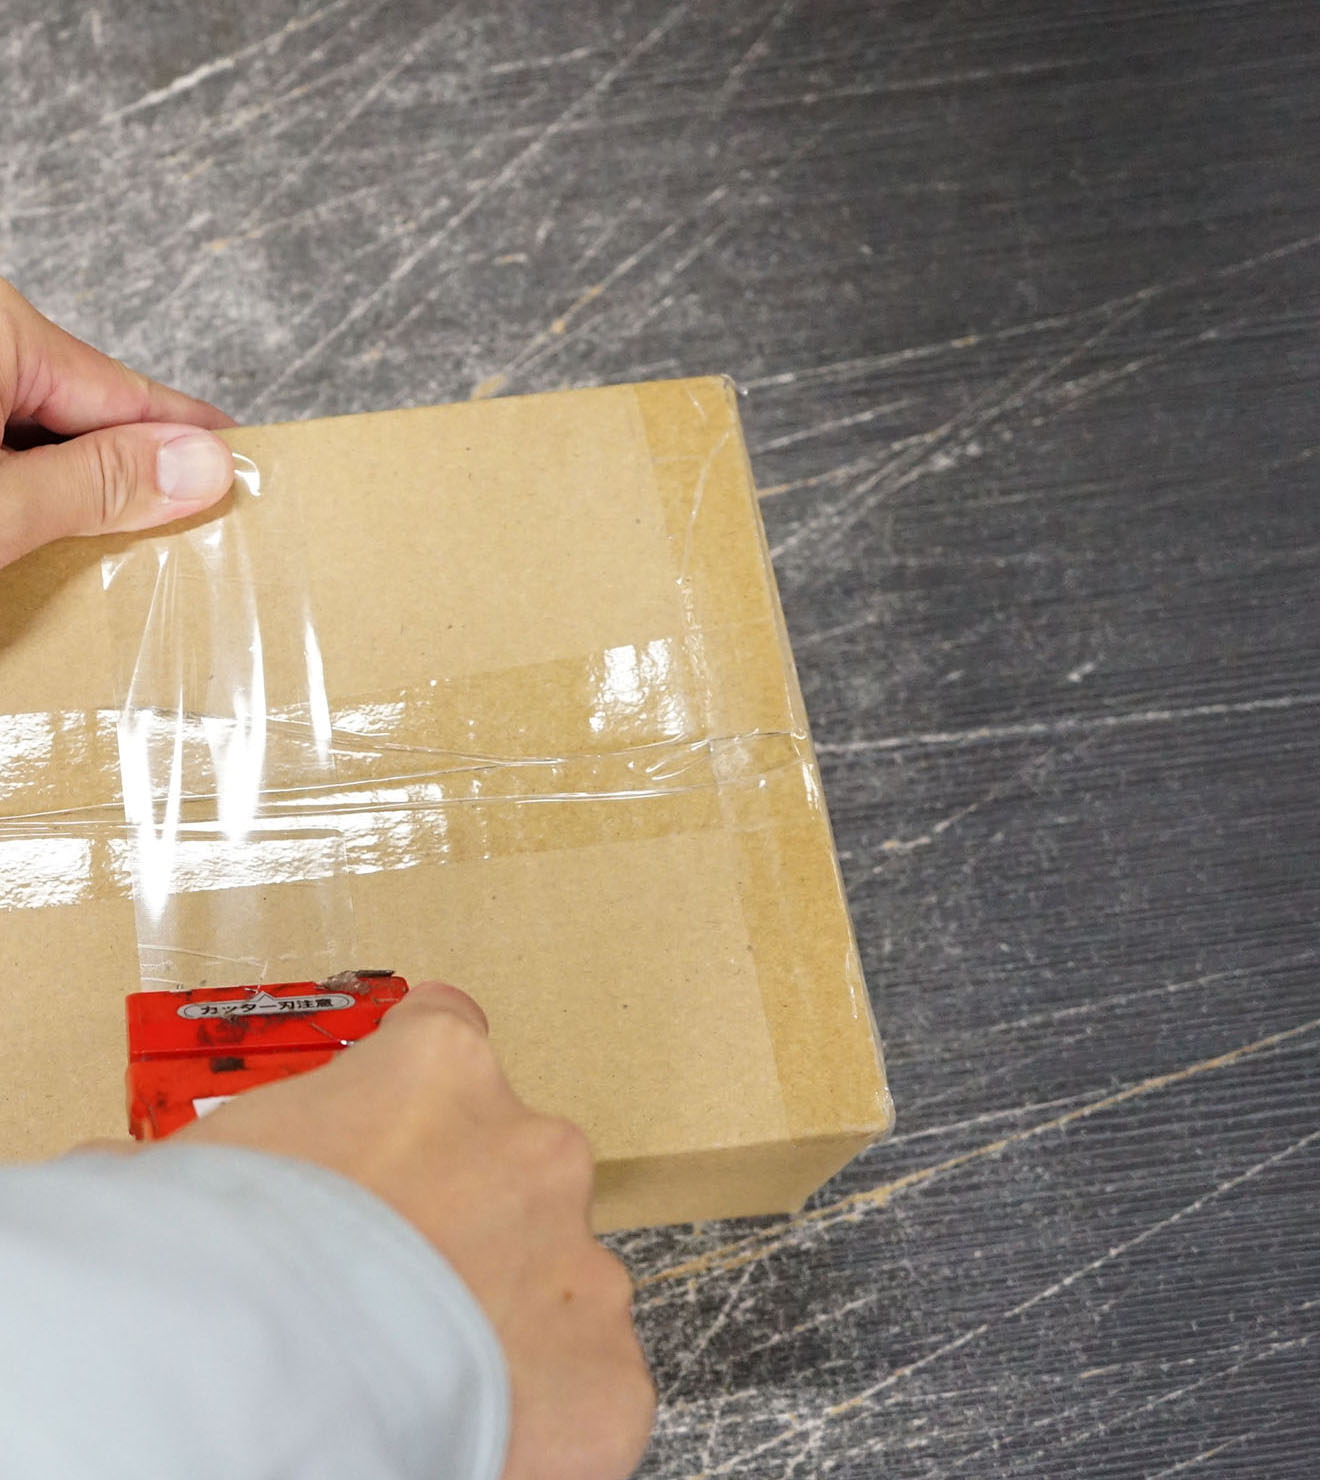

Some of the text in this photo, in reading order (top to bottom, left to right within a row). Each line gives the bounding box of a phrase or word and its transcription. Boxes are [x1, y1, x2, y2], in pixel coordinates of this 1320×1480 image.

[200, 998, 333, 1015] カッター刃注意
